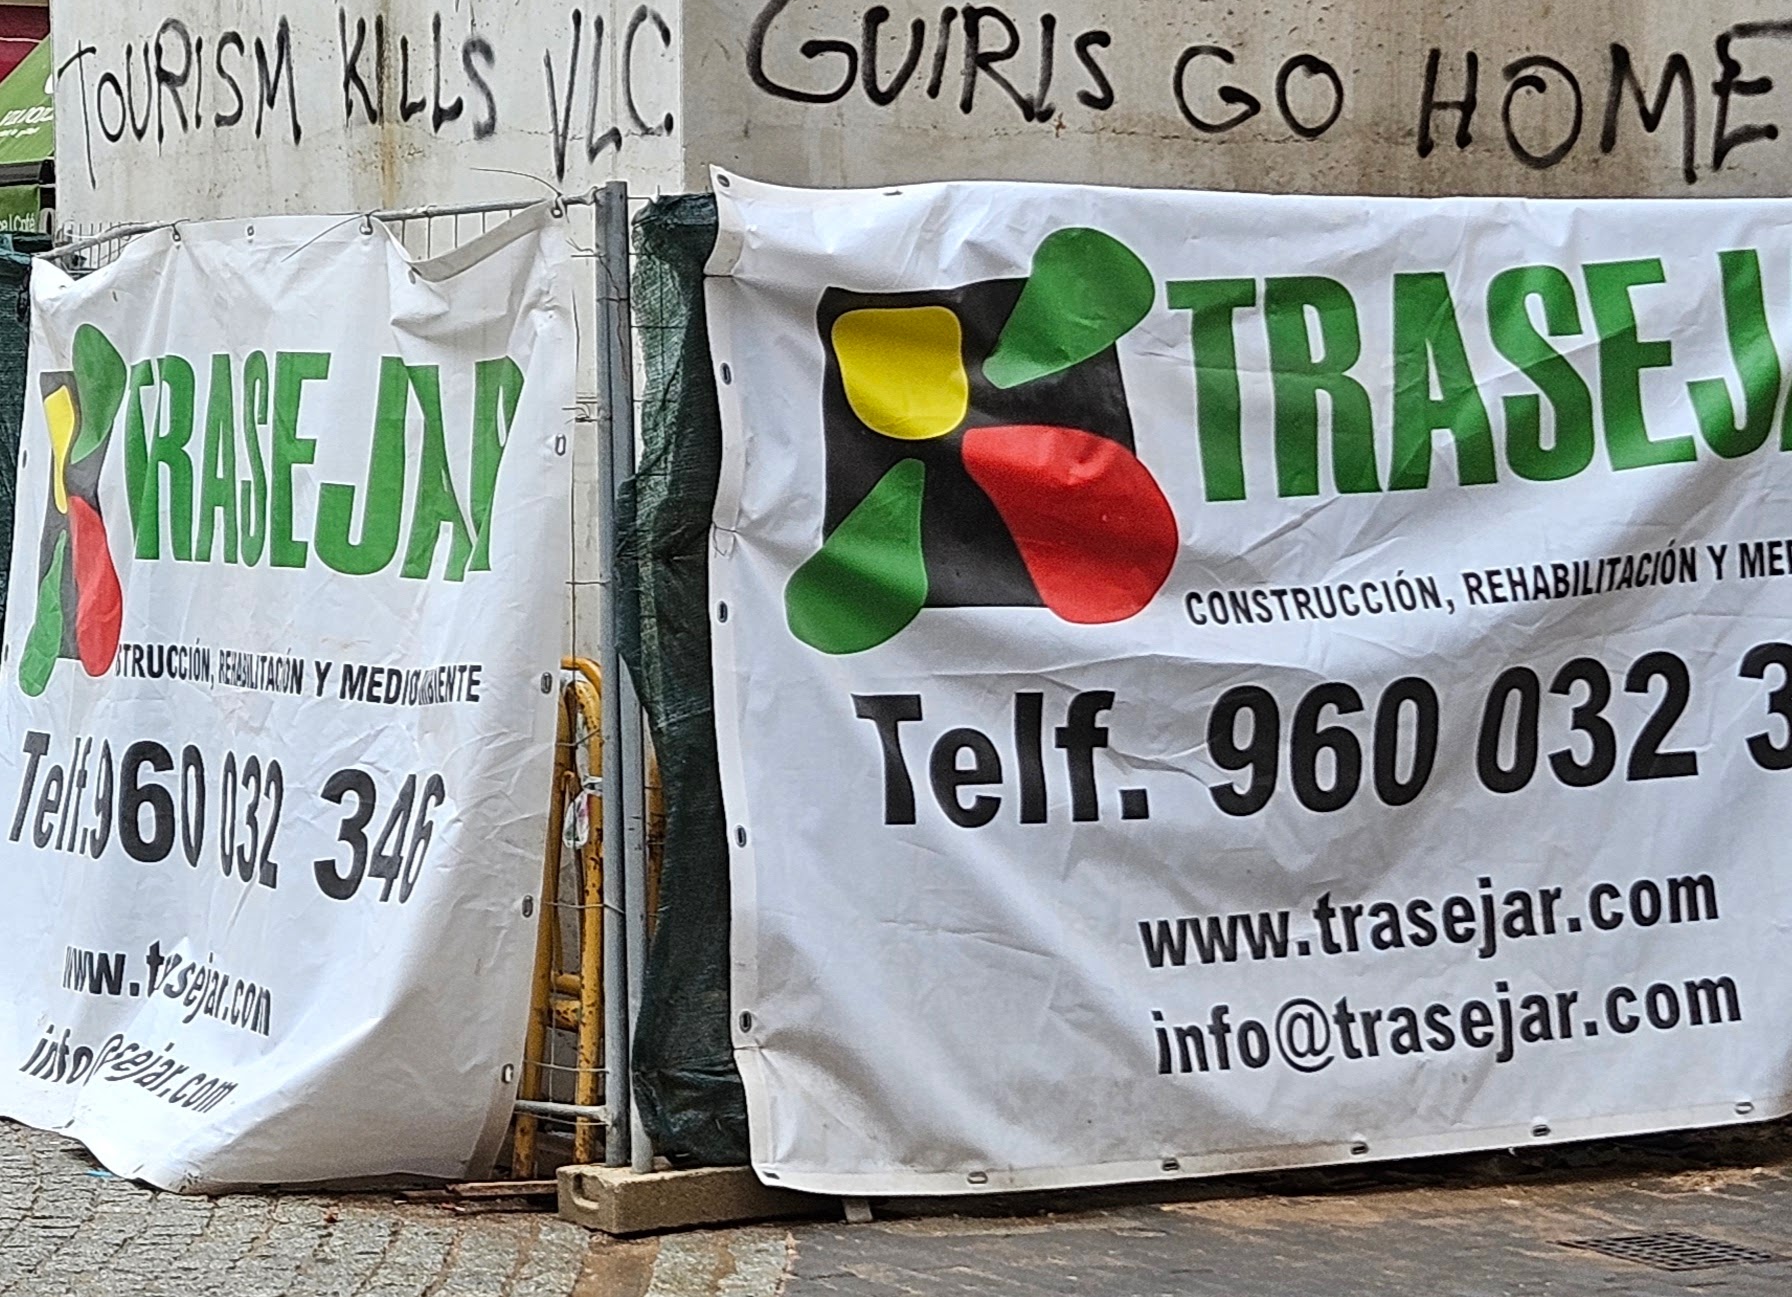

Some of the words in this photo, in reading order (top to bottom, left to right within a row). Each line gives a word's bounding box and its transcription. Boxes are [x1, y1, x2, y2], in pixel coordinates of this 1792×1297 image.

[58, 15, 302, 190] TOURISM
[339, 6, 496, 141] KILLS
[1173, 45, 1344, 139] GO
[1417, 20, 1792, 185] HOME
[1166, 249, 1792, 503] TRASEJ
[1186, 569, 1456, 627] CONSTRUCCIÓN,
[1468, 539, 1698, 607] REHABILITACIÓN
[1706, 544, 1728, 581] Y
[1738, 538, 1792, 580] ME
[315, 661, 333, 697] Y
[854, 689, 1150, 828] Telf.
[1208, 676, 1440, 817] 960
[1476, 651, 1699, 795] 032
[220, 751, 284, 889] 032
[313, 769, 445, 904] 346
[1139, 868, 1720, 968] www.trasejar.com
[1152, 971, 1742, 1077] info@trasejar.com
